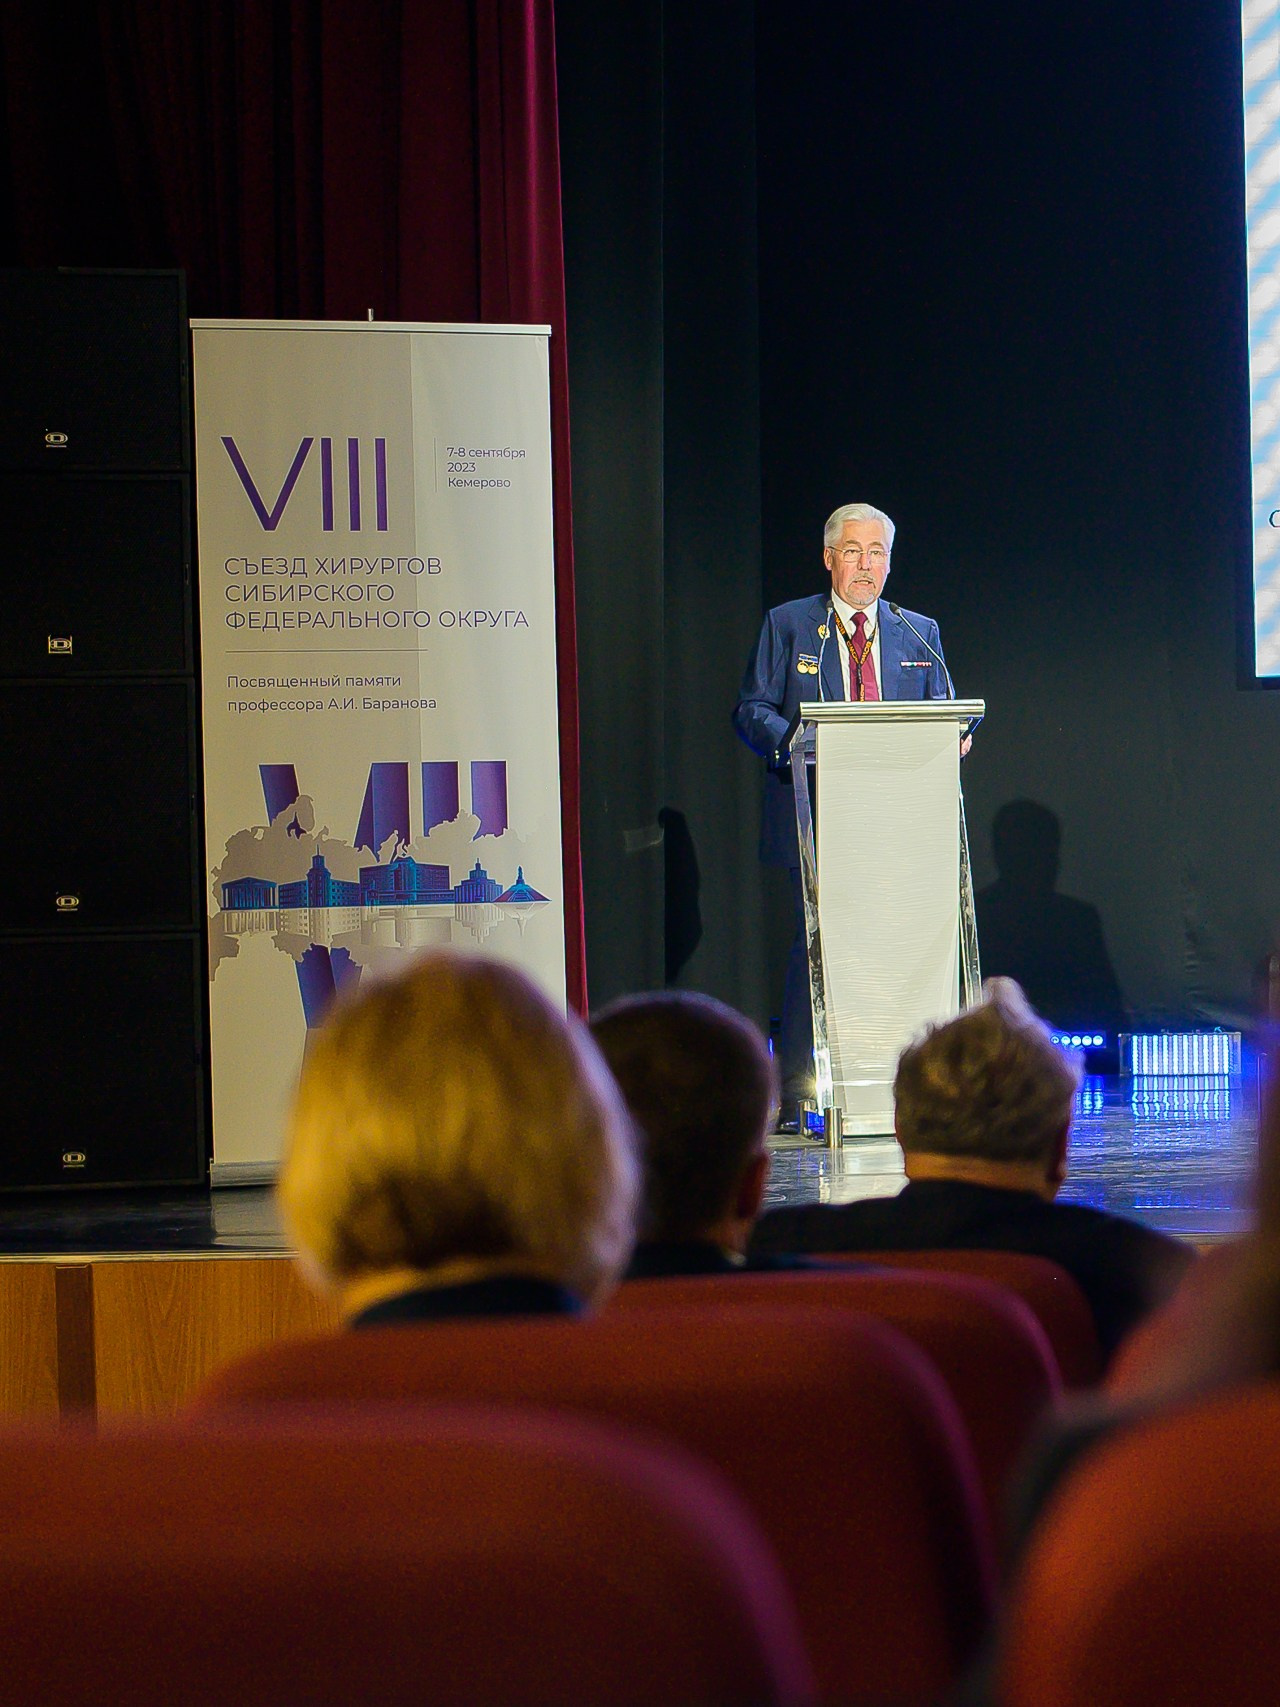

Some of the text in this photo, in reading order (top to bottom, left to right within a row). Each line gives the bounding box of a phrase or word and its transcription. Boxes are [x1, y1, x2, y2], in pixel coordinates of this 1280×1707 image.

[446, 447, 526, 460] 7-8 сентября
[447, 462, 476, 473] 2023
[220, 437, 388, 532] VIII
[448, 478, 512, 490] Кемерово
[224, 558, 442, 578] СЪЕЗД ХИРУРГОВ
[225, 584, 395, 602] СИБИРСКОГО
[226, 610, 530, 632] ФЕДЕРАЛЬНОГО ОКРУГА
[227, 675, 402, 690] Посвященный памяти
[228, 698, 437, 713] профессора А.И. Баранова
